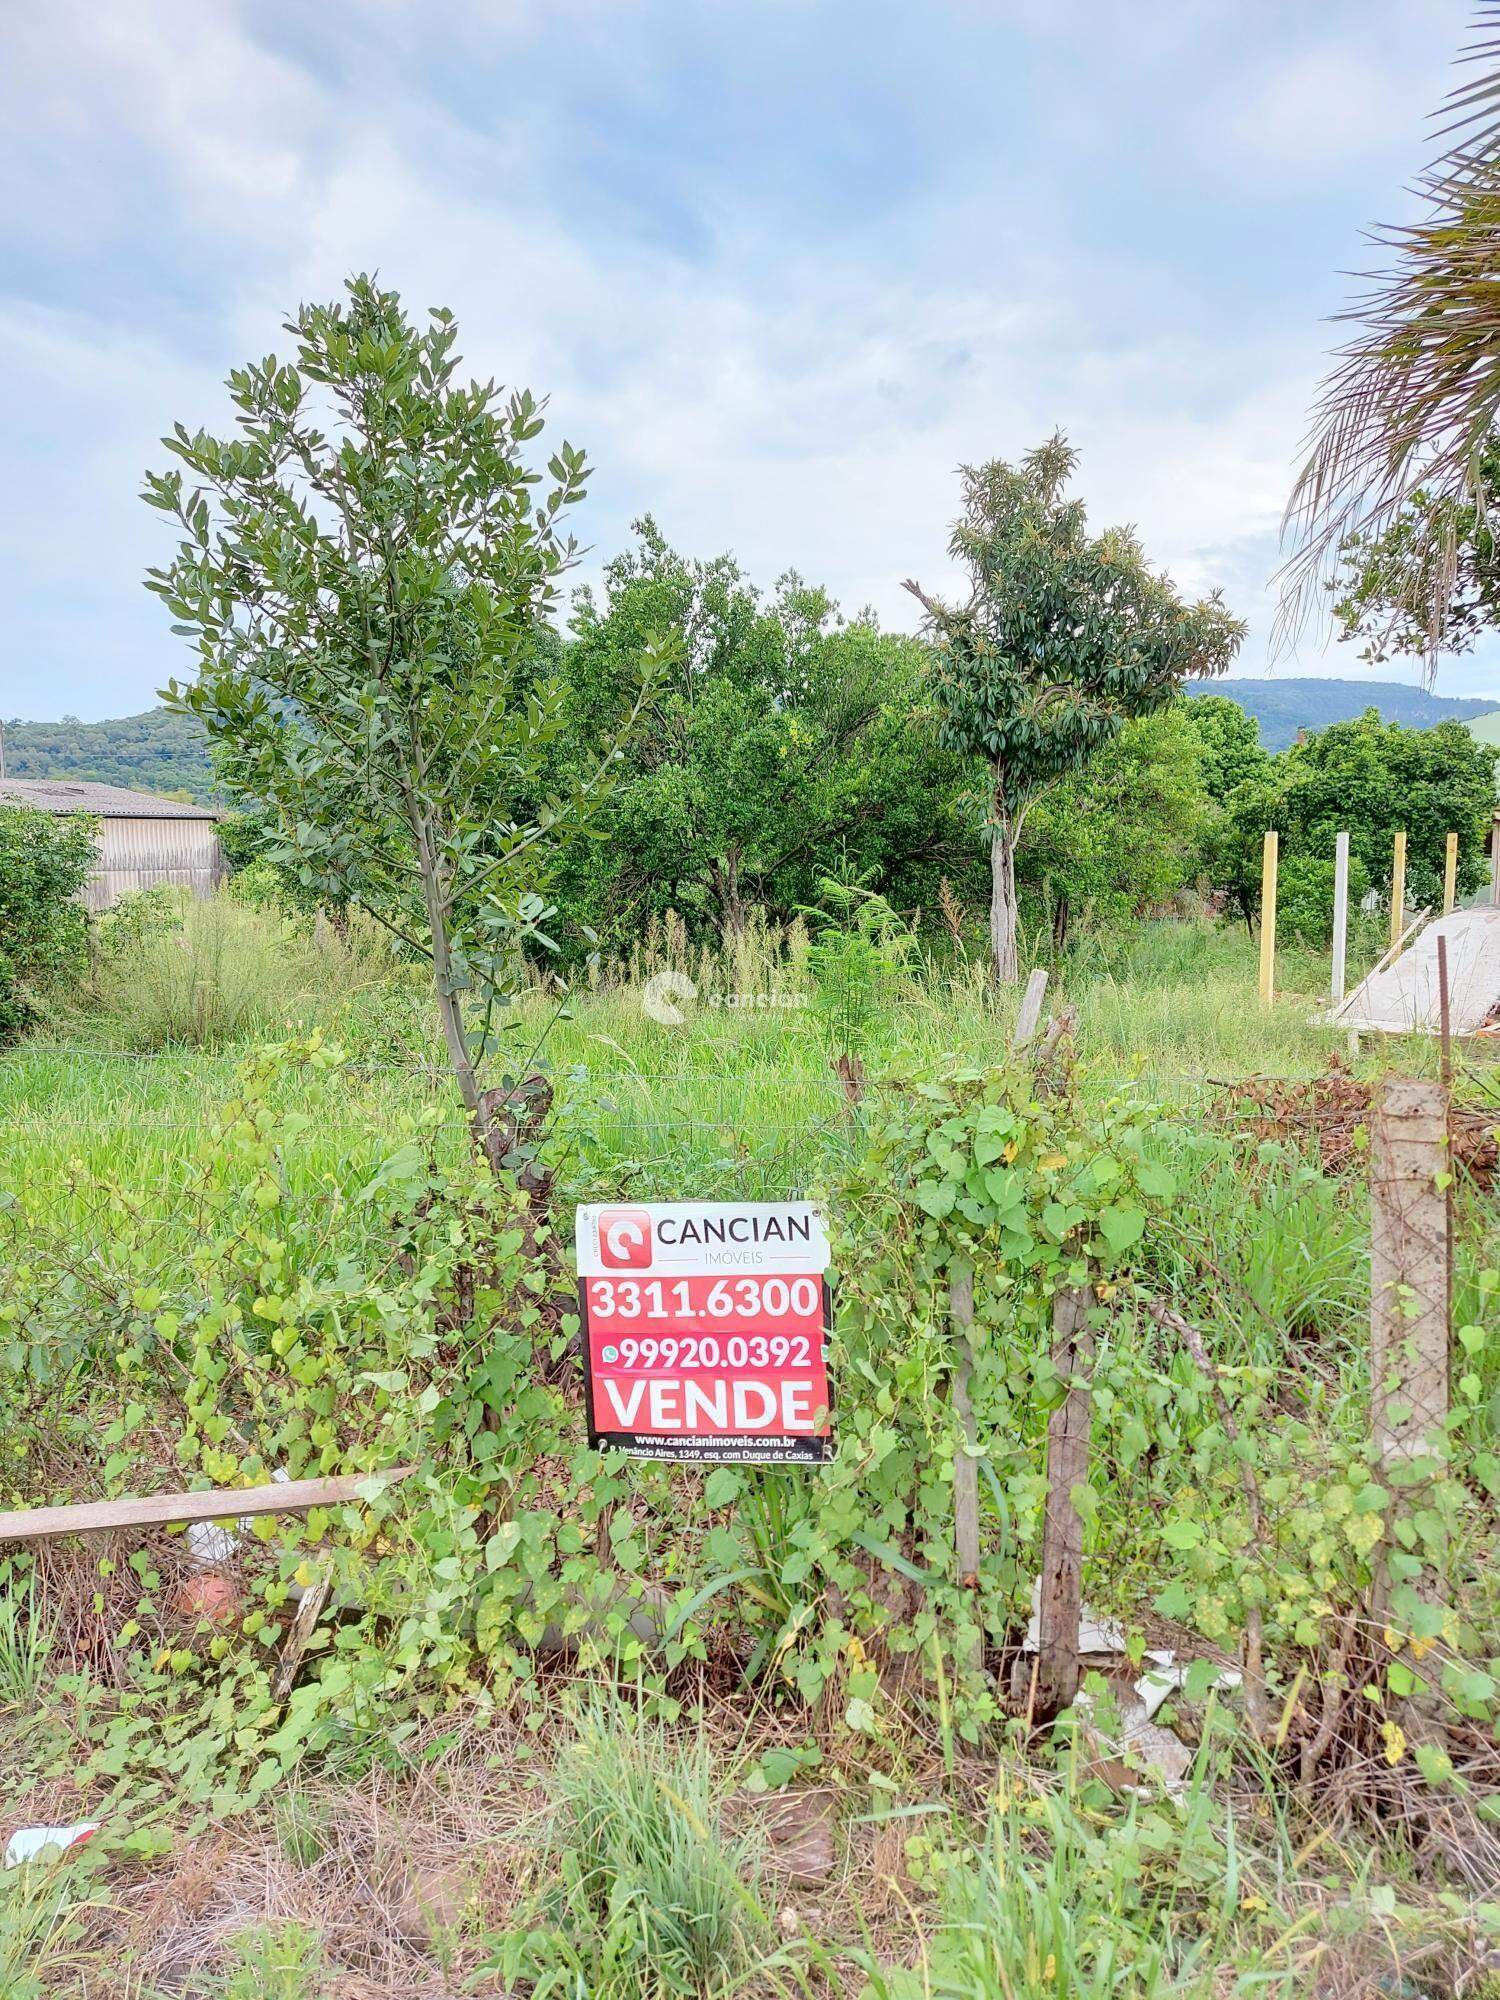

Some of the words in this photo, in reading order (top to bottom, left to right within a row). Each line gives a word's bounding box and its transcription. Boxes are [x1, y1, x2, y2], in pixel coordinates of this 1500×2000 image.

[656, 1215, 811, 1246] CANCIAN
[704, 1250, 763, 1265] IMÓVEIS
[591, 1278, 819, 1319] 3311.6300
[619, 1336, 812, 1369] 99920.0392
[603, 1378, 815, 1430] VENDE
[634, 1435, 797, 1448] www.cancianimoveis.com.br
[654, 1449, 677, 1459] Aires,
[703, 1452, 721, 1460] esq.
[742, 1450, 771, 1461] Duque
[772, 1450, 784, 1459] de
[785, 1451, 814, 1460] Caxias
